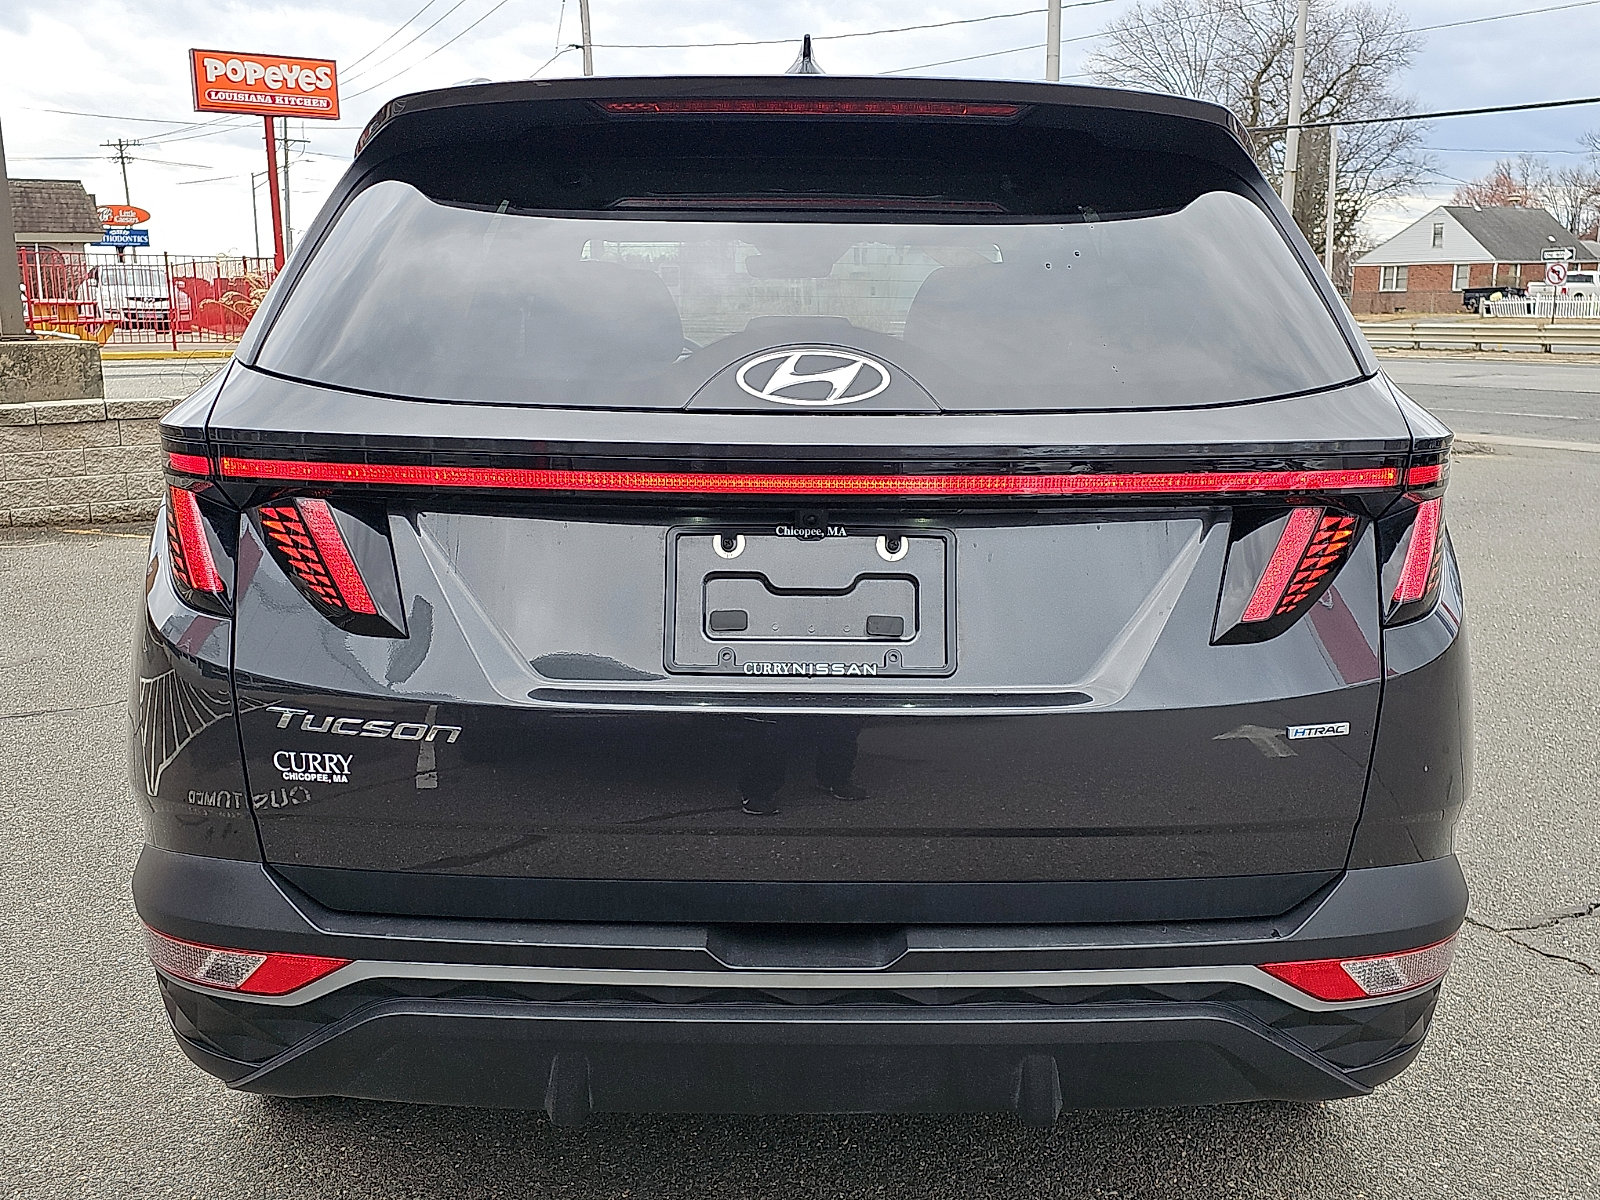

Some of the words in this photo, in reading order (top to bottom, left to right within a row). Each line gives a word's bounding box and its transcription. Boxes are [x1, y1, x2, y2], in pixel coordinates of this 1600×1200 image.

[210, 91, 271, 104] LOUISIANA
[274, 95, 328, 108] KITCHEN
[119, 209, 137, 217] Little
[102, 235, 148, 243] THODONTICS
[775, 525, 825, 538] Chicopee,
[827, 526, 847, 537] MA
[743, 662, 793, 675] CURRY
[792, 663, 877, 676] NISSAN
[1294, 725, 1346, 737] HTRAC
[273, 750, 354, 774] CURRY
[282, 771, 332, 784] CHICOPEE,
[333, 774, 348, 783] MA
